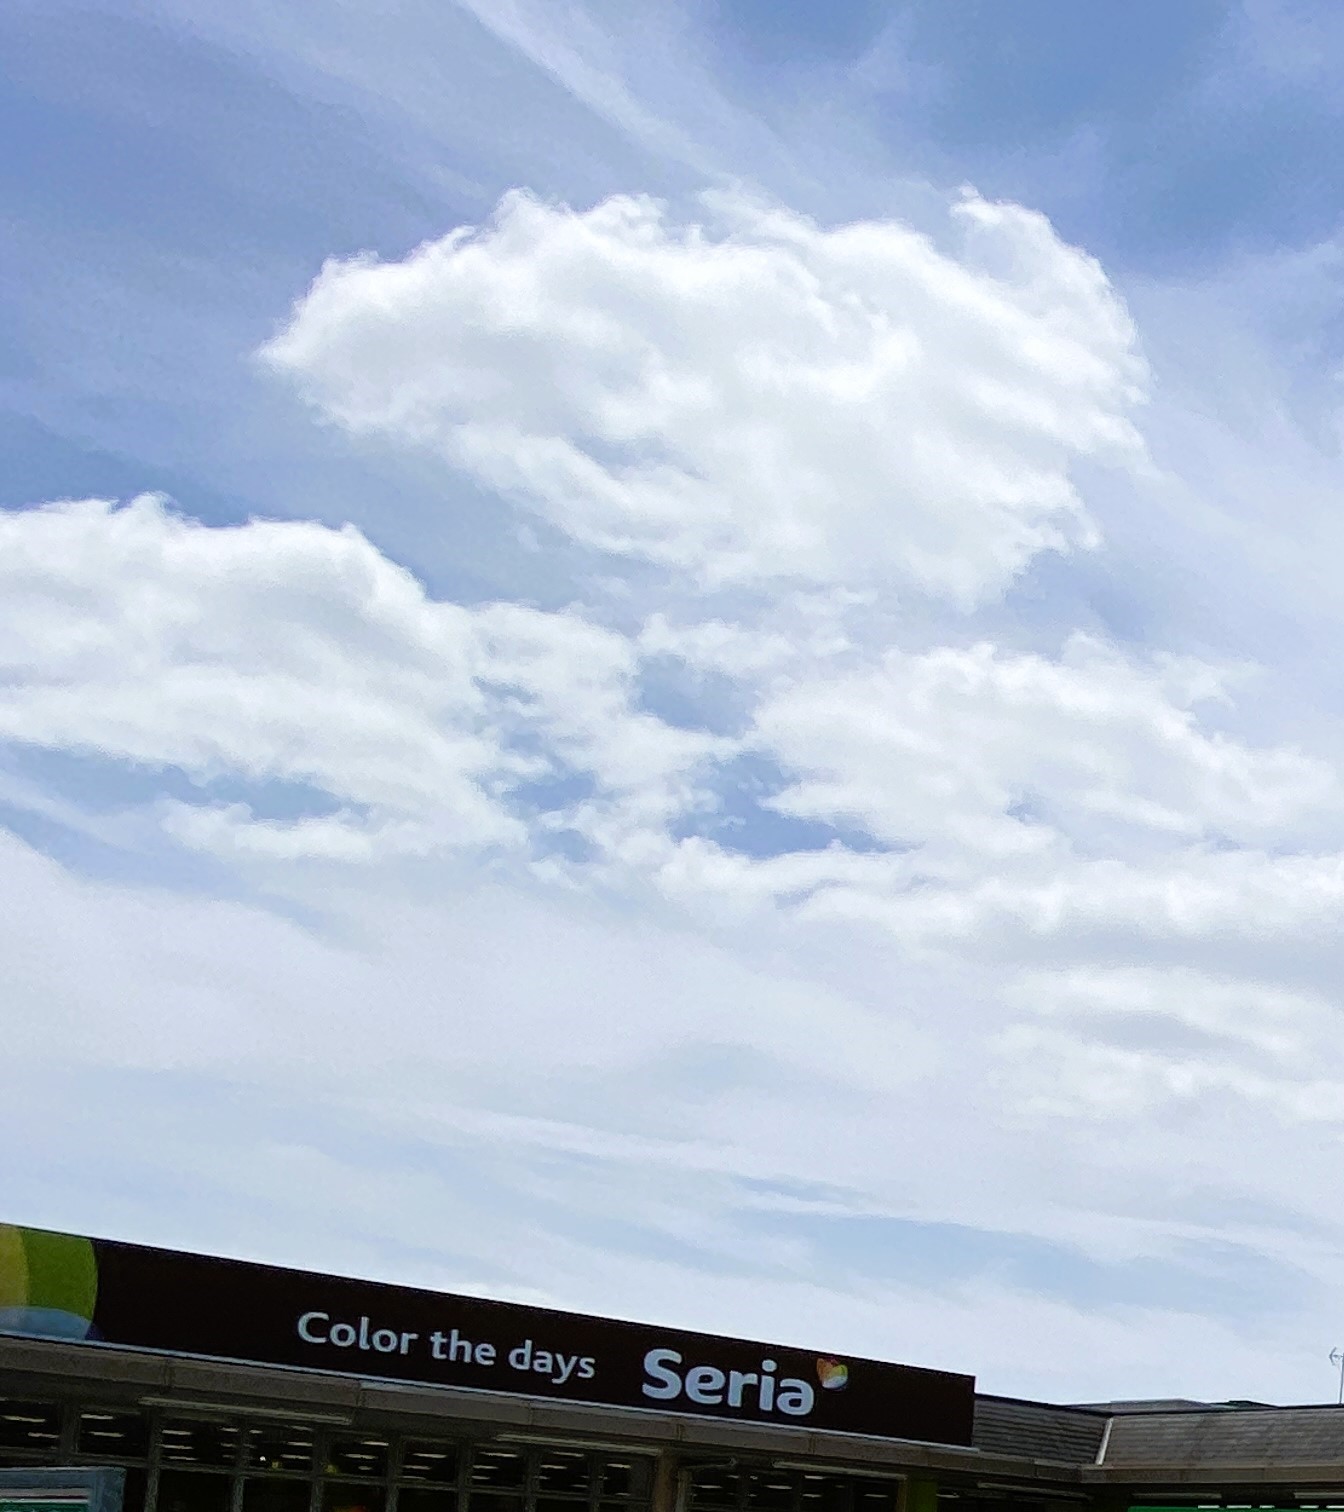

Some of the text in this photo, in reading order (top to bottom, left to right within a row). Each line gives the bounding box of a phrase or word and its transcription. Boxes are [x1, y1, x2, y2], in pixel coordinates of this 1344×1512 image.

[297, 1311, 596, 1385] Color the days
[642, 1348, 815, 1416] Seria
